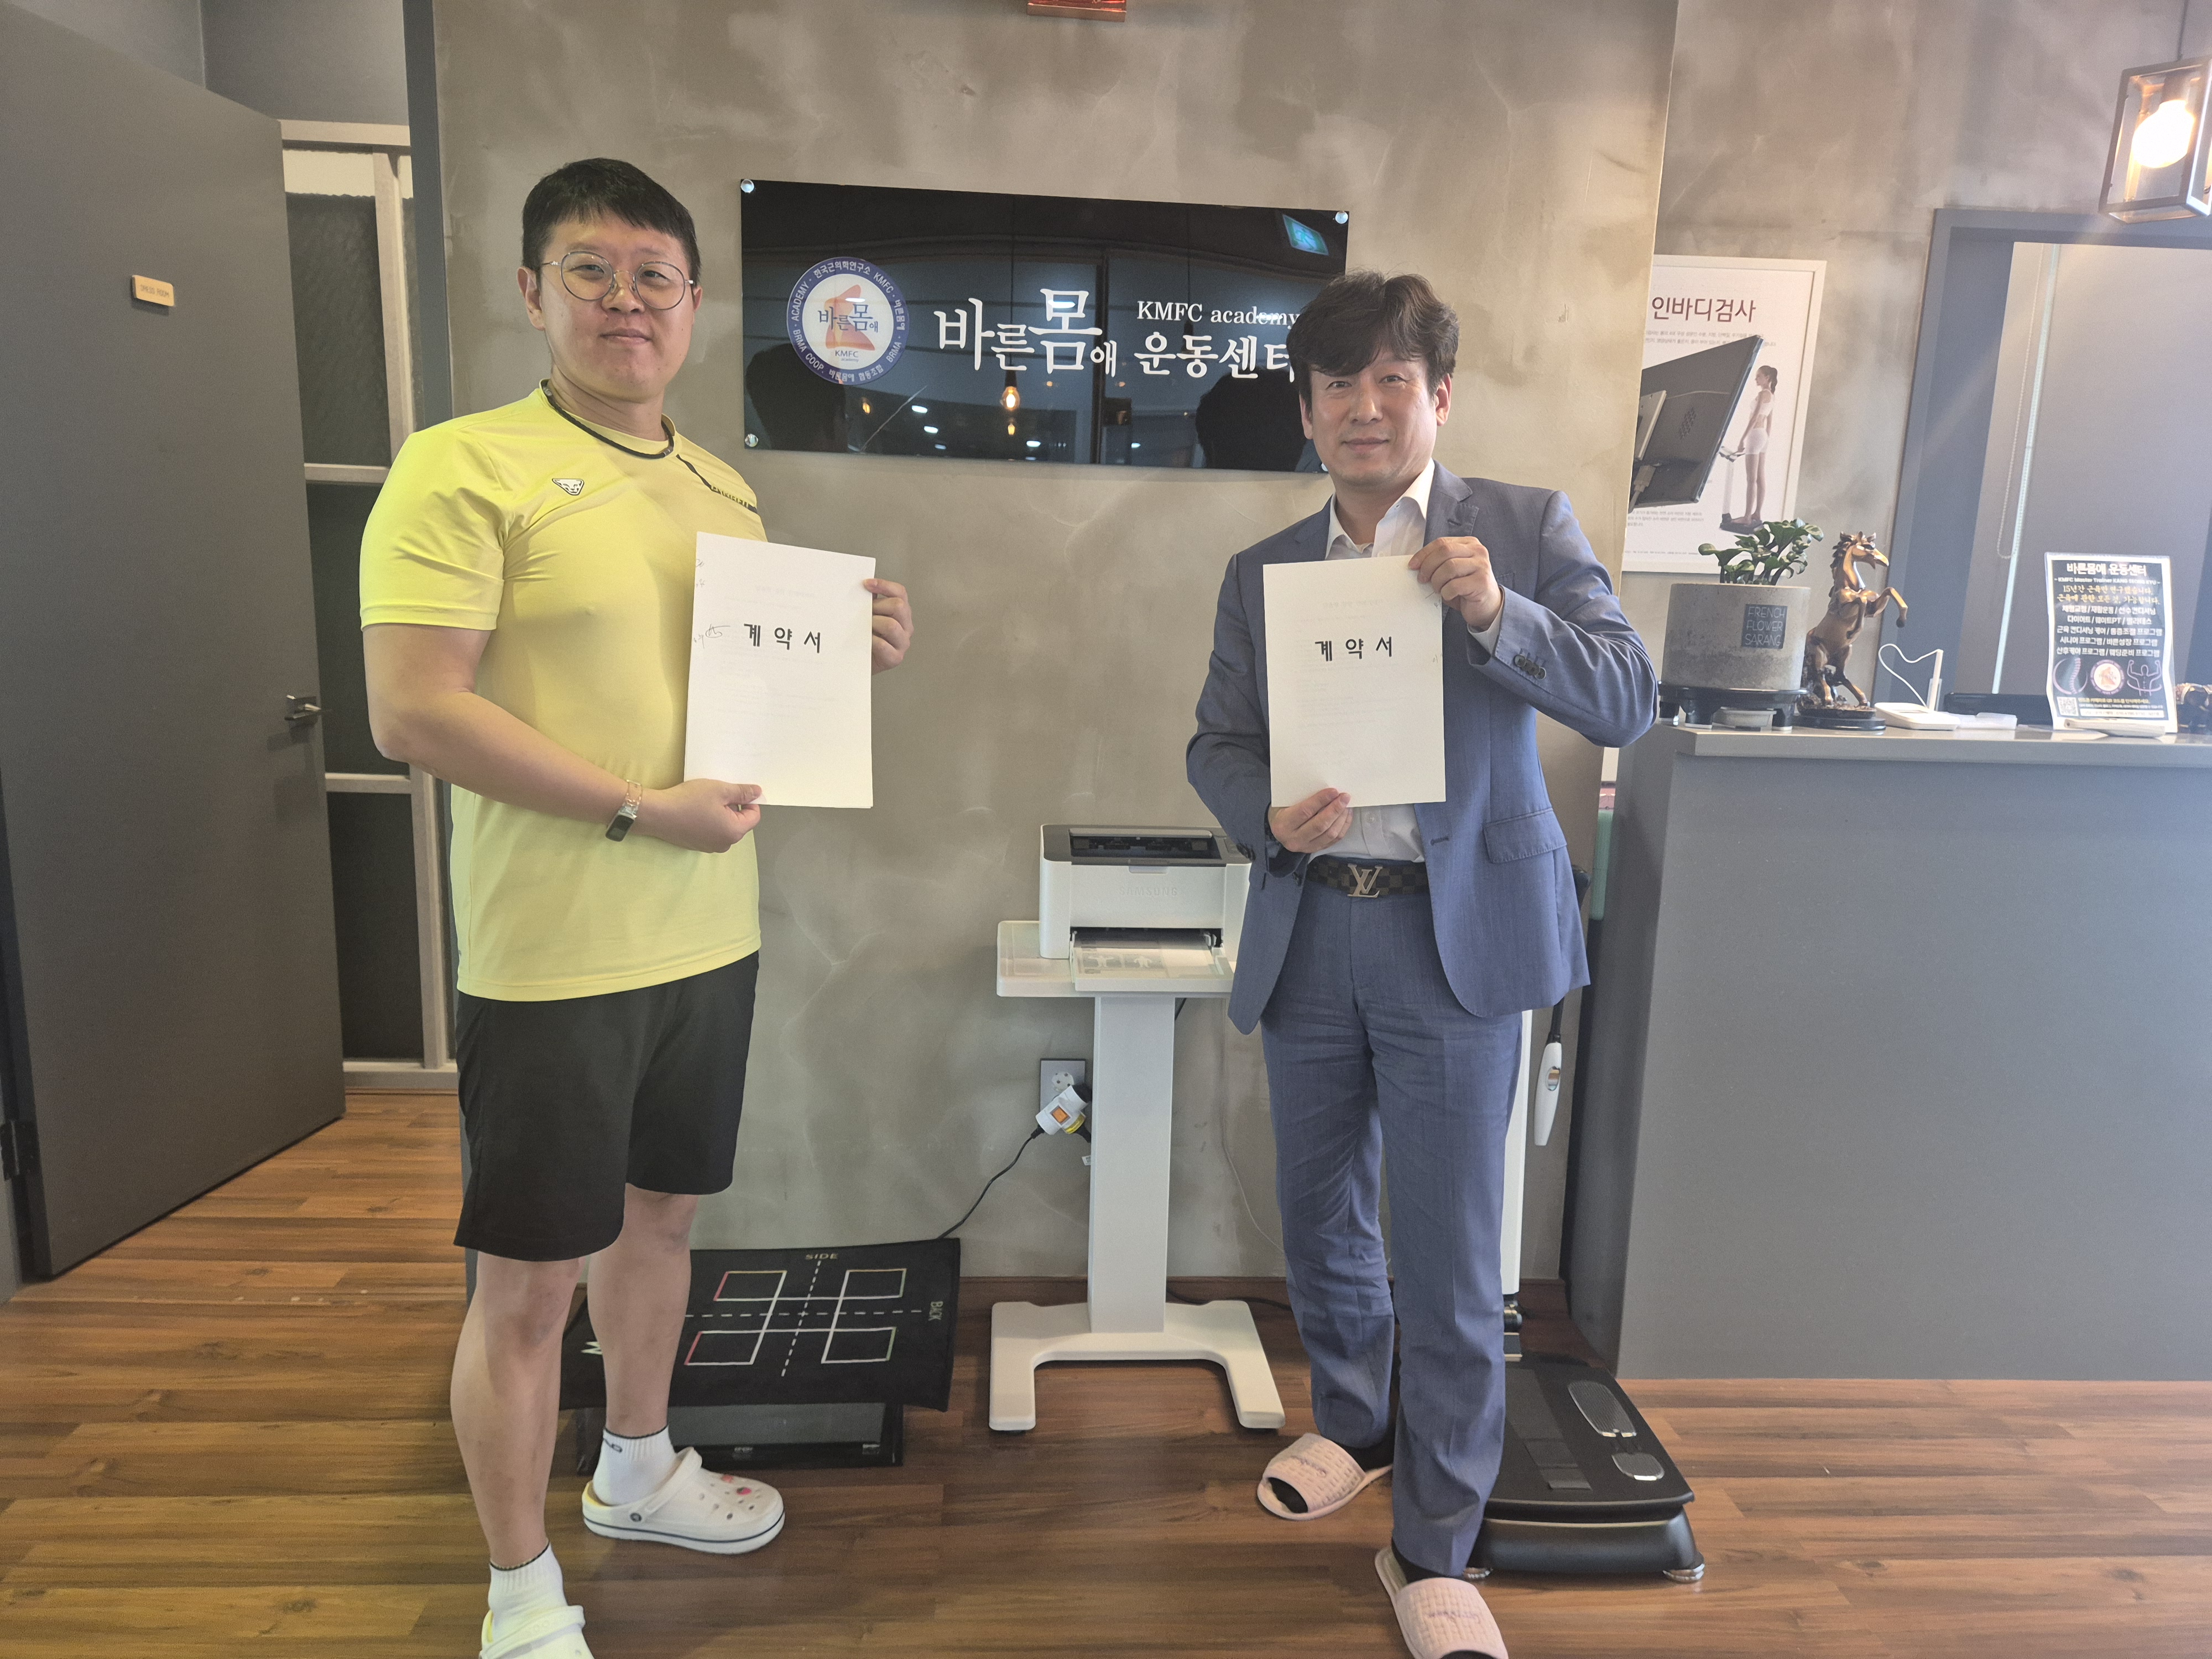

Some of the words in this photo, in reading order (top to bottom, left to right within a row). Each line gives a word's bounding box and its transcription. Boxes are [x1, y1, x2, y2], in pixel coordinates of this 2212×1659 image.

[813, 261, 871, 279] 한국근의학연구소
[873, 272, 894, 294] KMFC
[791, 281, 809, 321] ACADEMY
[1136, 299, 1203, 322] KMFC
[1211, 306, 1301, 330] academy
[1652, 296, 1756, 323] 인바디검사
[818, 304, 878, 333] 바른몸애
[793, 329, 807, 352] BRMA
[885, 341, 902, 363] BRMA
[934, 288, 1117, 378] 바른몸애
[1134, 330, 1295, 383] 운동센터
[2109, 563, 2147, 577] 운동센터
[1746, 620, 1783, 632] FLOWER
[1748, 607, 1785, 618] FRENCH
[1745, 633, 1781, 646] SARANG
[1119, 886, 1177, 896] SAMSUNG
[928, 1301, 944, 1321] BACK
